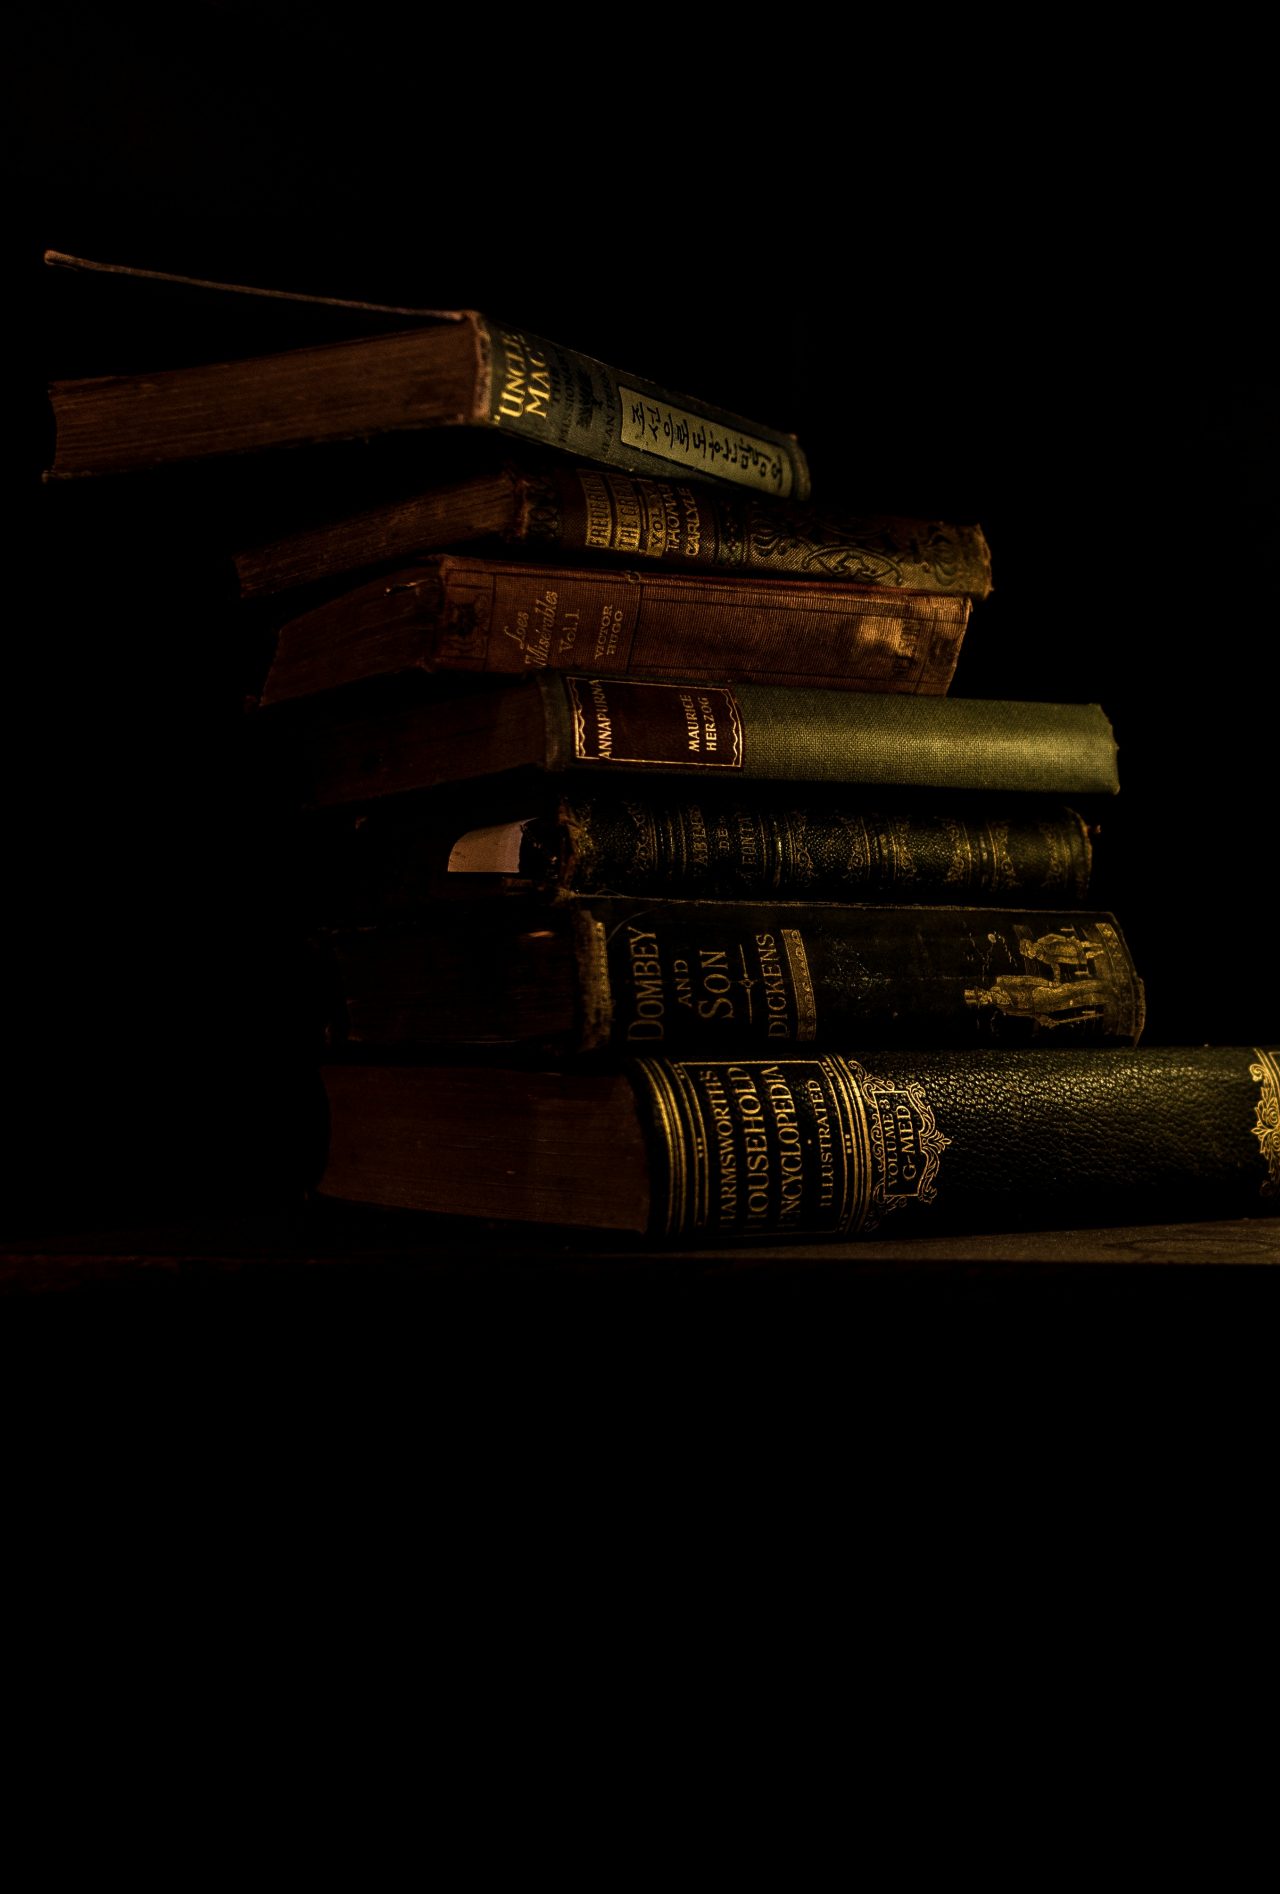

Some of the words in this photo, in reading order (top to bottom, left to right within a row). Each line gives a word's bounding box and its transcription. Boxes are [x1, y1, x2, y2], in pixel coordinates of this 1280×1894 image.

[679, 486, 700, 556] CARLYLE
[524, 590, 559, 666] Misérables
[594, 604, 613, 660] VICTOR
[606, 610, 623, 655] HUGO
[588, 679, 612, 760] ANNAPURNA
[680, 694, 701, 752] MAURICE
[698, 697, 717, 751] HERZOG
[626, 926, 665, 1041] DOMBEY
[674, 959, 693, 1007] AND
[698, 950, 736, 1020] SON
[756, 933, 790, 1040] DICKENS
[879, 1098, 892, 1110] 3
[727, 1066, 770, 1229] HOUSEHOLD
[761, 1065, 803, 1228] ENCYCLOPEDIA
[807, 1079, 835, 1208] ILLUSTRATED
[883, 1112, 900, 1188] VOLUME
[896, 1105, 918, 1181] G-MED
